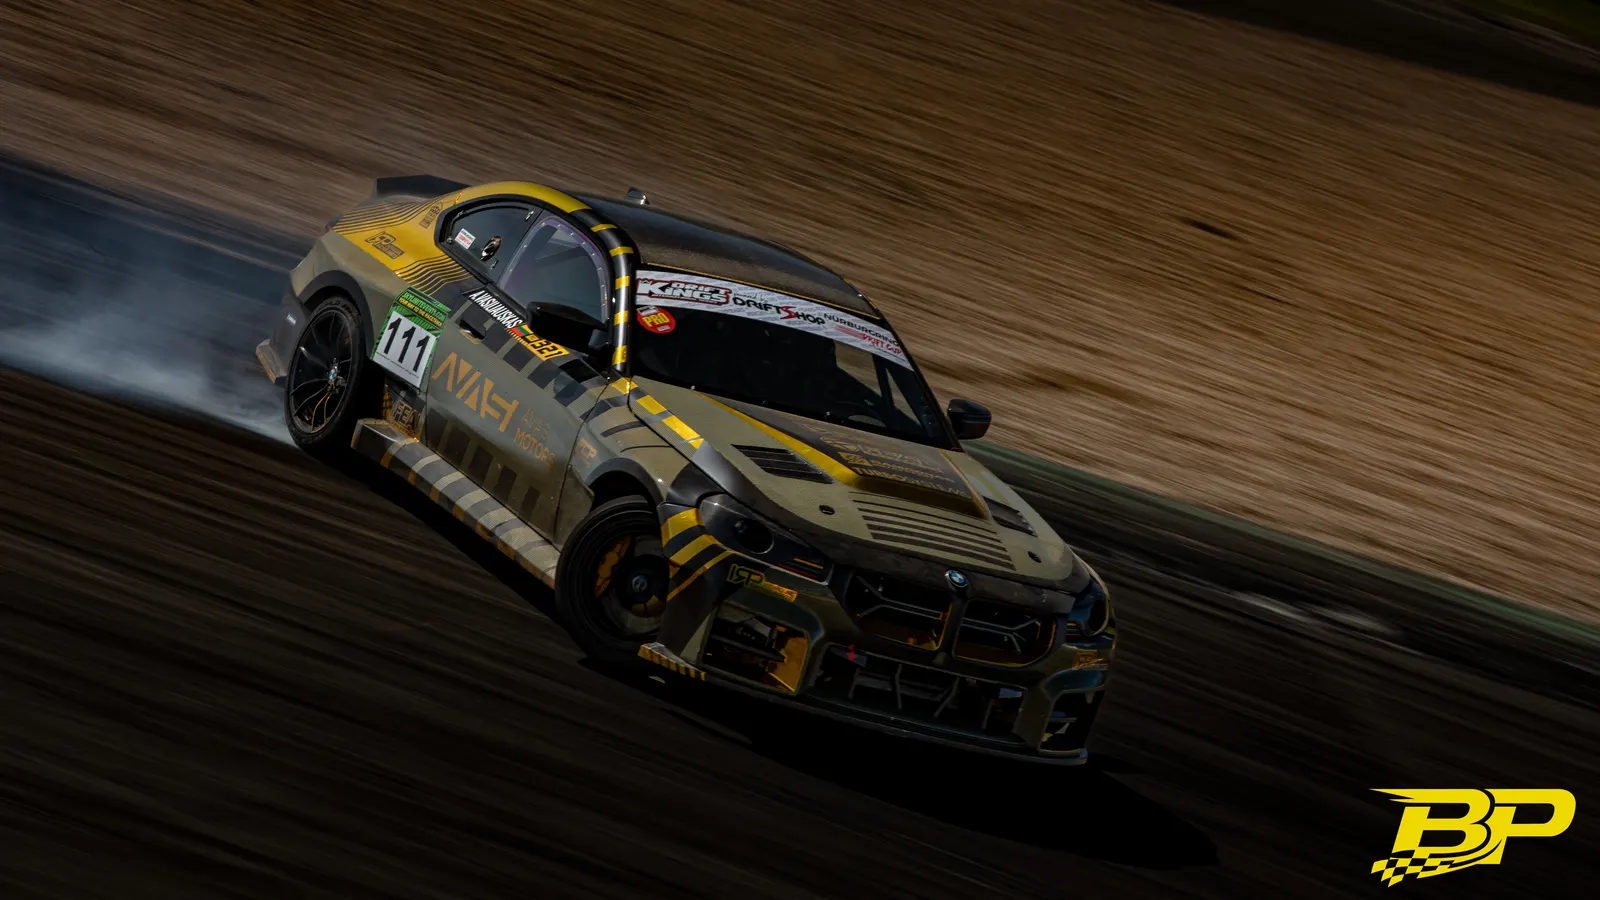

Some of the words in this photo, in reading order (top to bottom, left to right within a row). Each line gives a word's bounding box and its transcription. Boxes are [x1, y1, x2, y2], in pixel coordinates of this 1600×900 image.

[672, 282, 731, 298] DRIFT
[642, 312, 671, 328] PRO
[383, 317, 430, 372] 111
[513, 428, 557, 469] MOTORS
